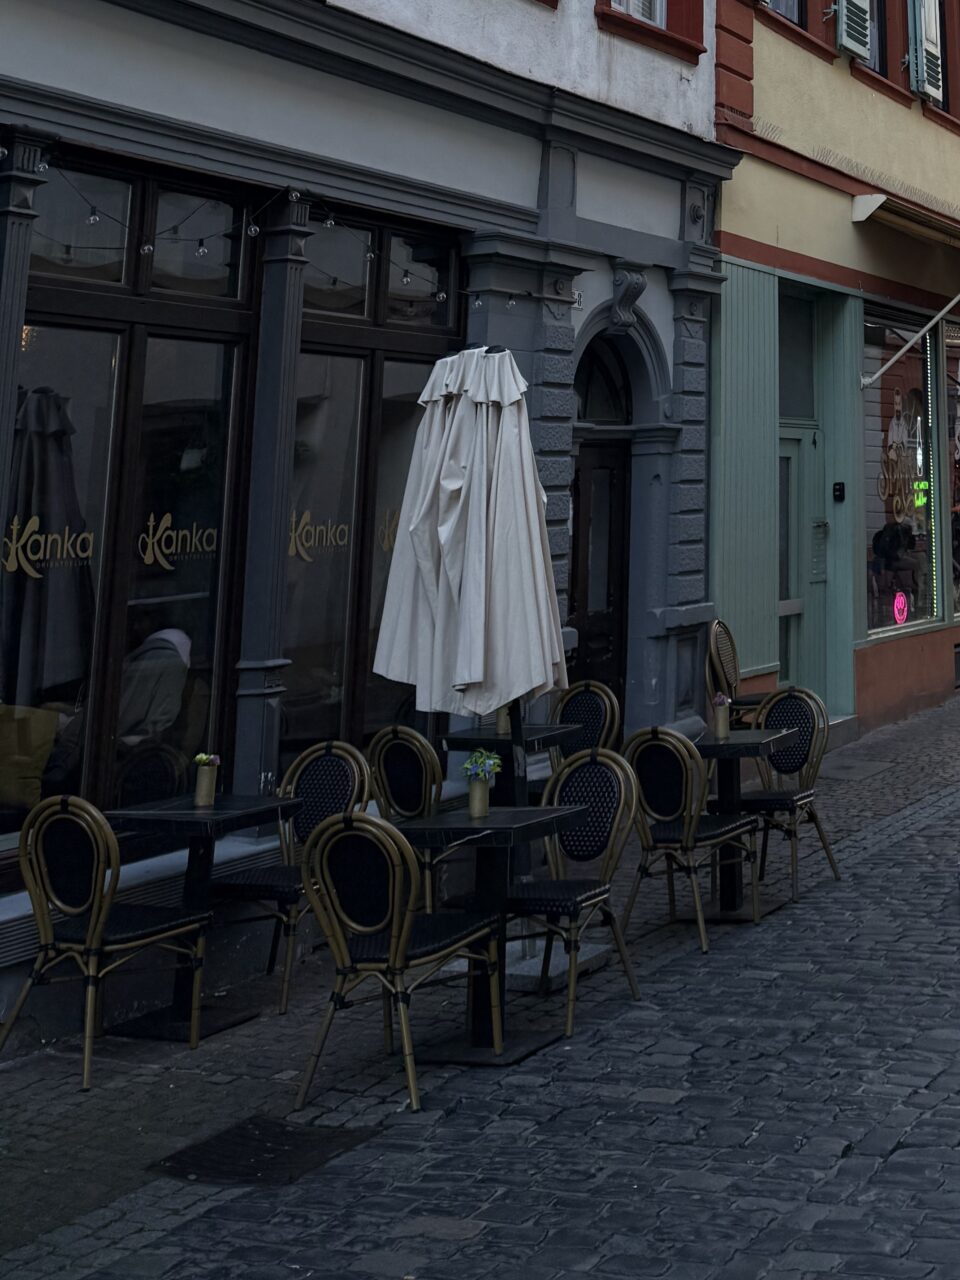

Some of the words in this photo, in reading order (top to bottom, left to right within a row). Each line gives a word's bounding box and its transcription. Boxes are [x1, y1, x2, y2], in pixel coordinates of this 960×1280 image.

[2, 514, 94, 578] Kanka
[138, 512, 218, 570] Kanka
[288, 510, 349, 562] Kanka
